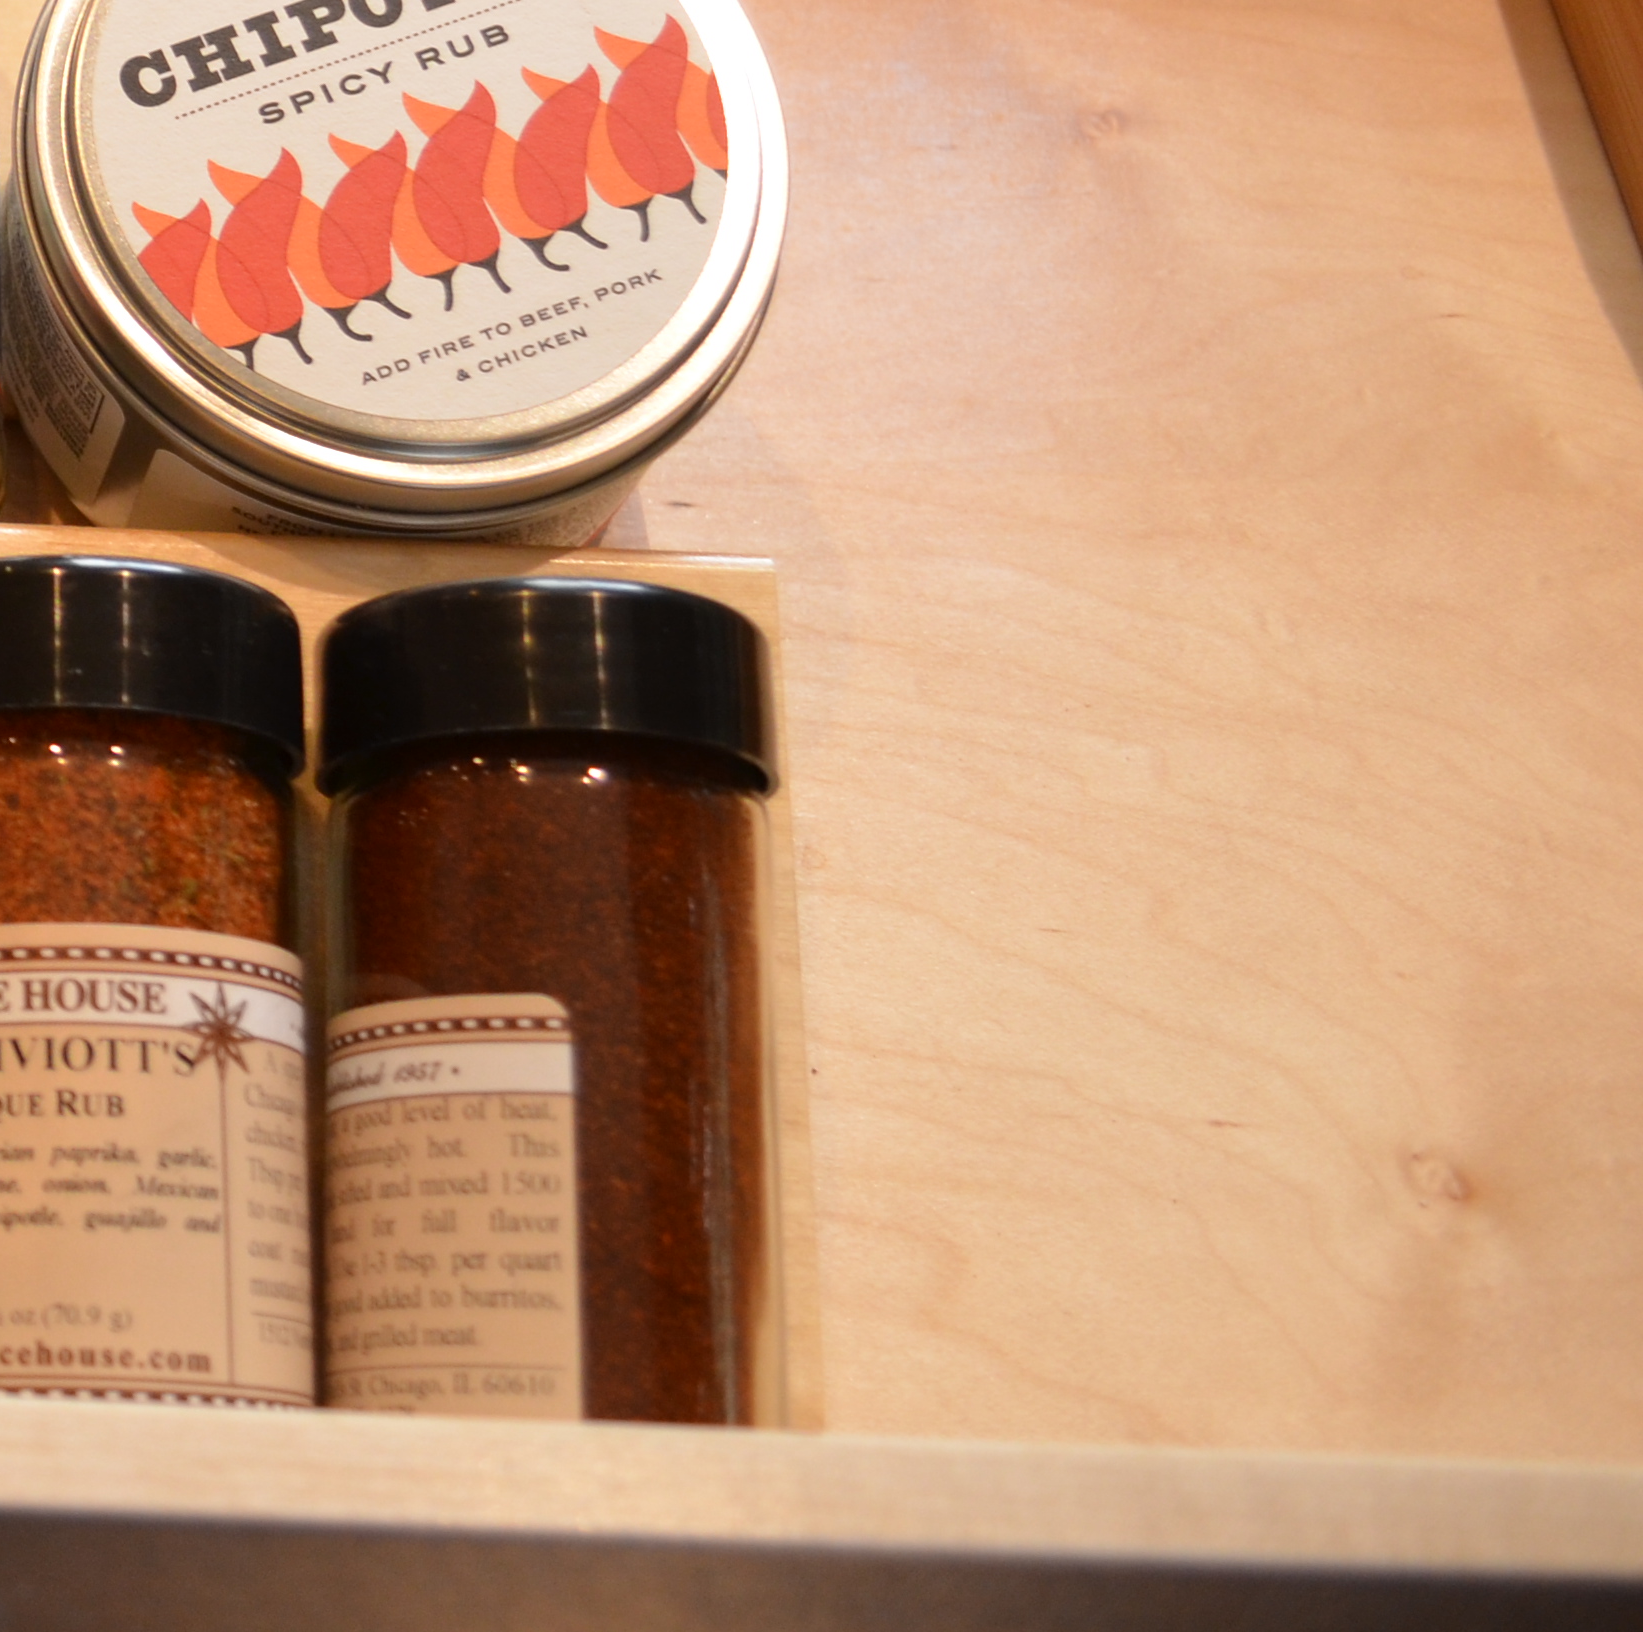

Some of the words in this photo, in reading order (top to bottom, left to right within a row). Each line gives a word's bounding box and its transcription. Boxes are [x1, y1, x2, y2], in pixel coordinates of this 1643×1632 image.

[257, 60, 395, 125] SPICY
[415, 23, 512, 71] RUB
[360, 355, 412, 386] ADD
[418, 334, 475, 366] FIRE
[479, 321, 513, 344] TO
[519, 293, 590, 330] BEEF,
[594, 268, 664, 303] PORK
[454, 366, 472, 383] &
[478, 325, 590, 374] CHICKEN
[21, 978, 168, 1015] HOUSE
[55, 1087, 127, 1118] RUB
